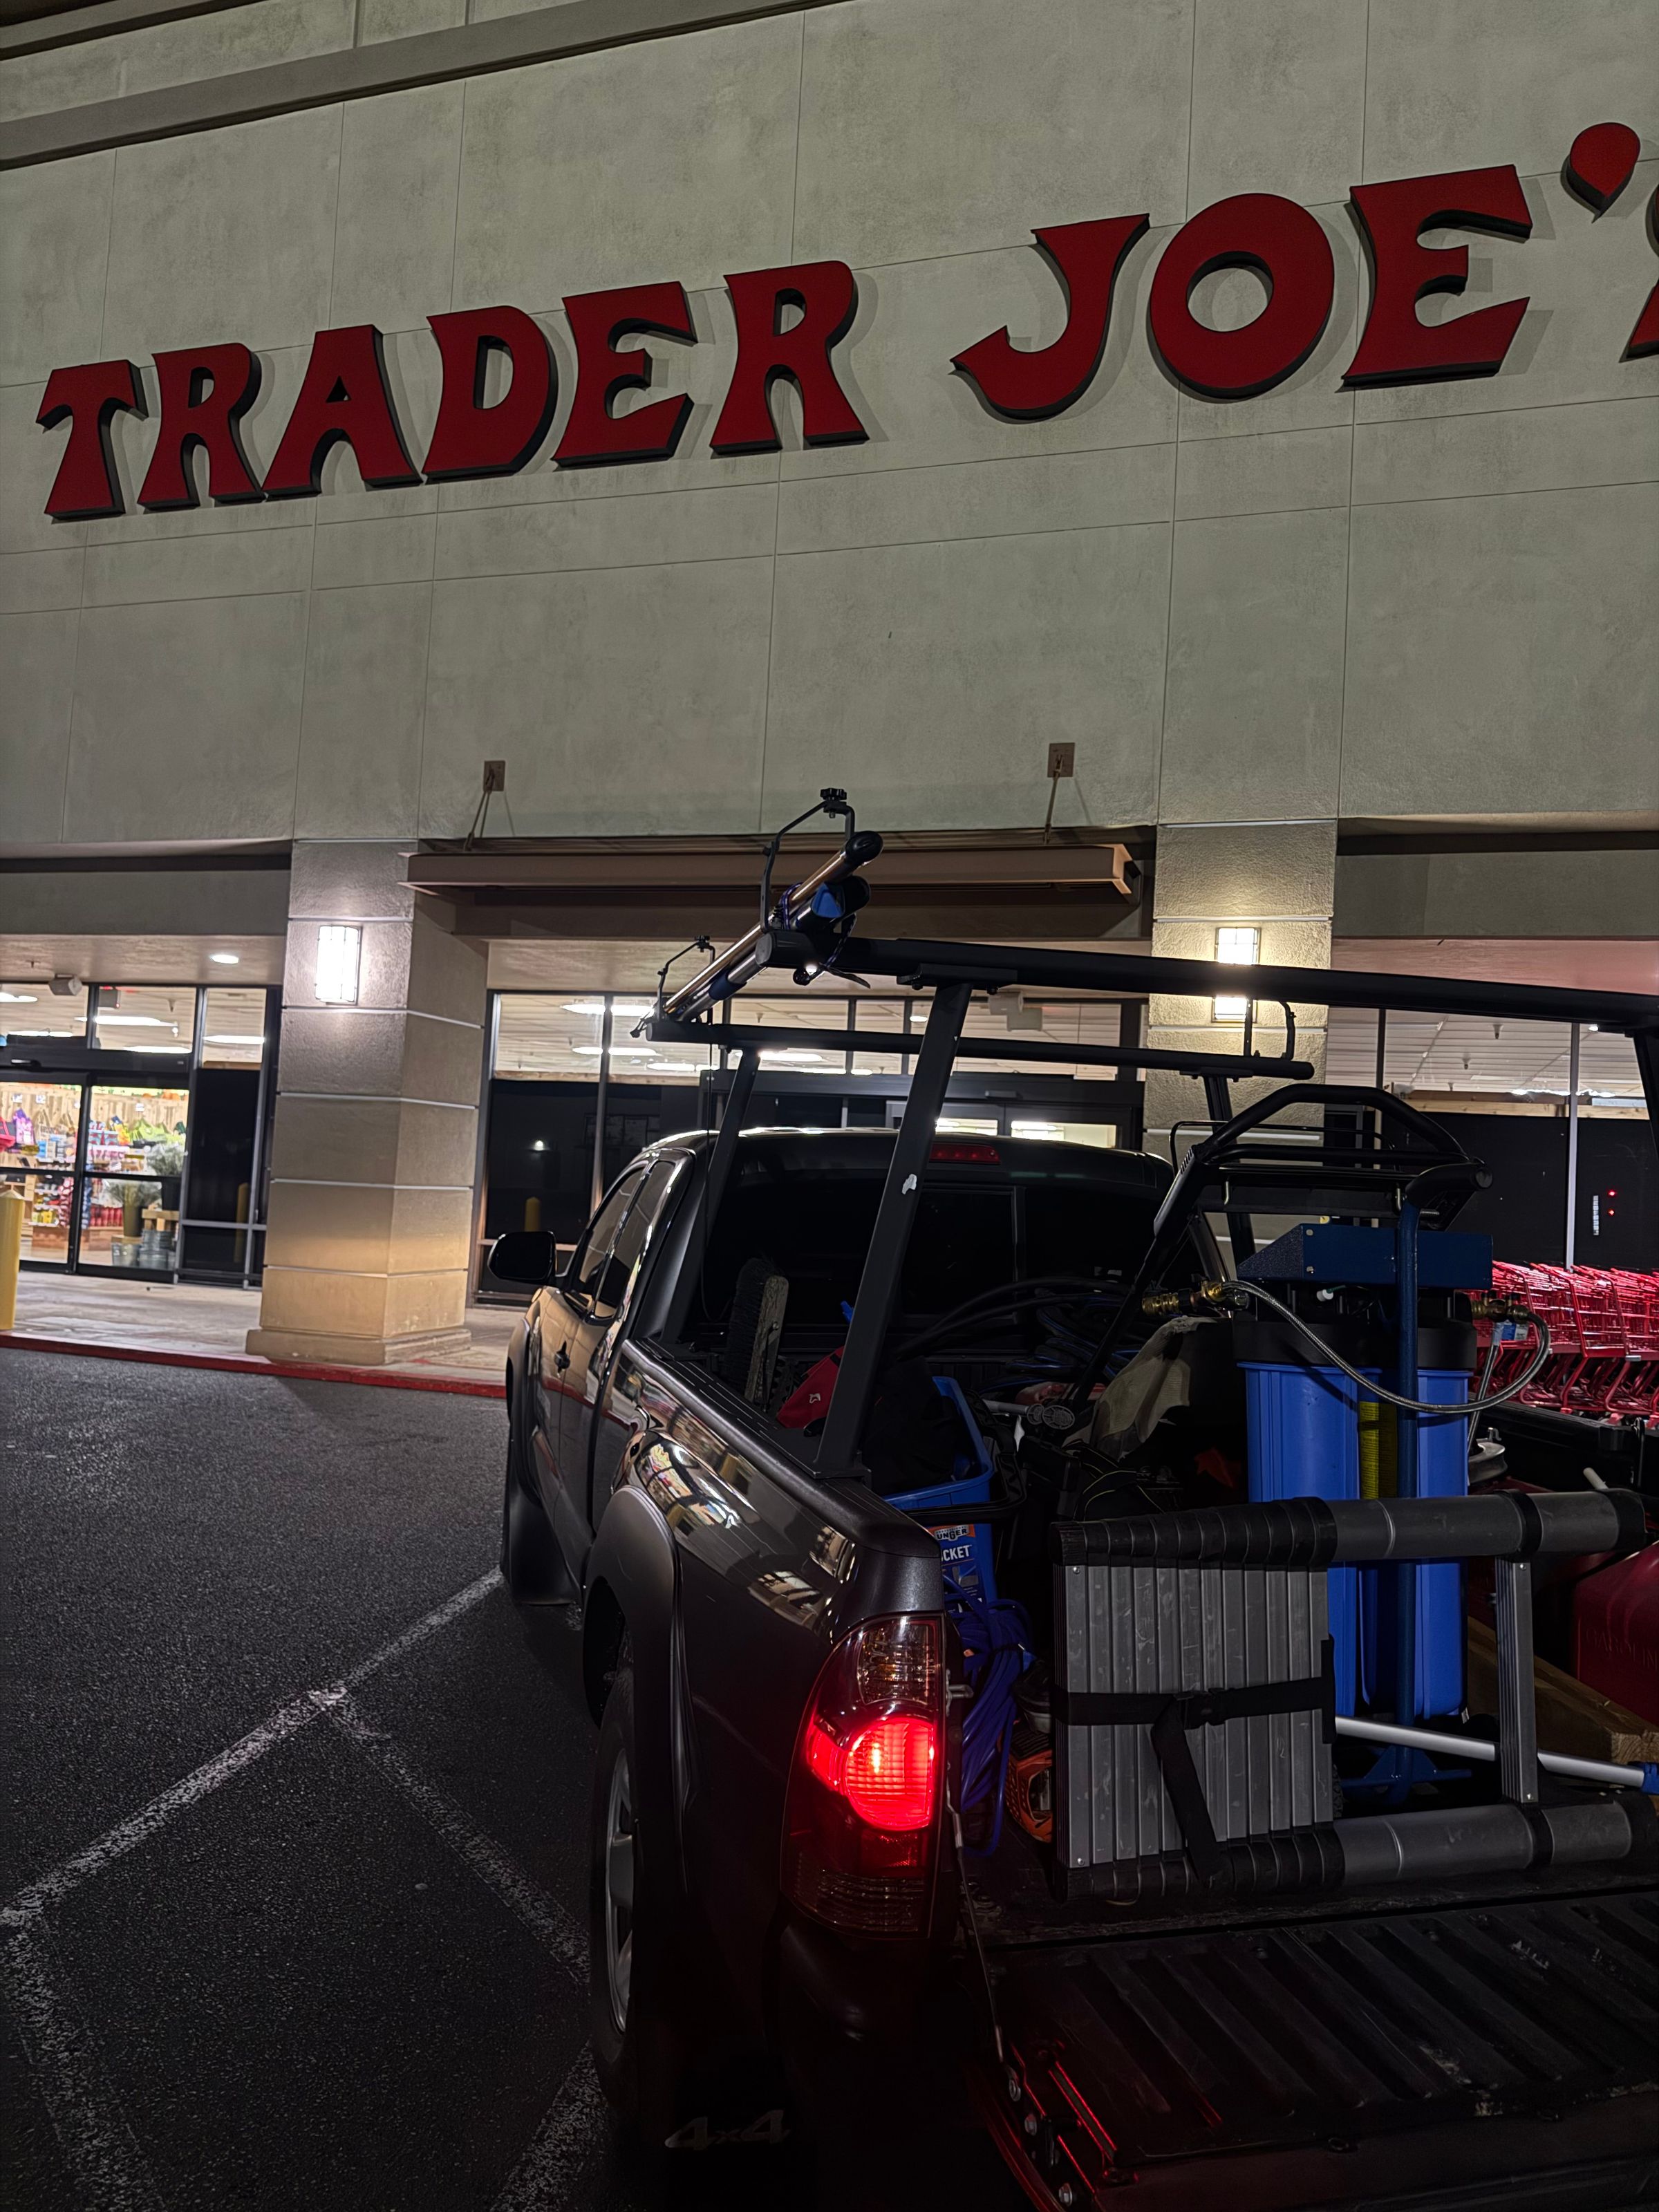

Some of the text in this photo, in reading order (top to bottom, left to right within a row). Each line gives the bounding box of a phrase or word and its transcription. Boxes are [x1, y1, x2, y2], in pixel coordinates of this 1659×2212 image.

[36, 122, 1659, 521] TRADER JOE'
[937, 1528, 967, 1539] UNGER
[941, 1545, 972, 1562] CKET
[664, 2110, 791, 2150] 4x4
